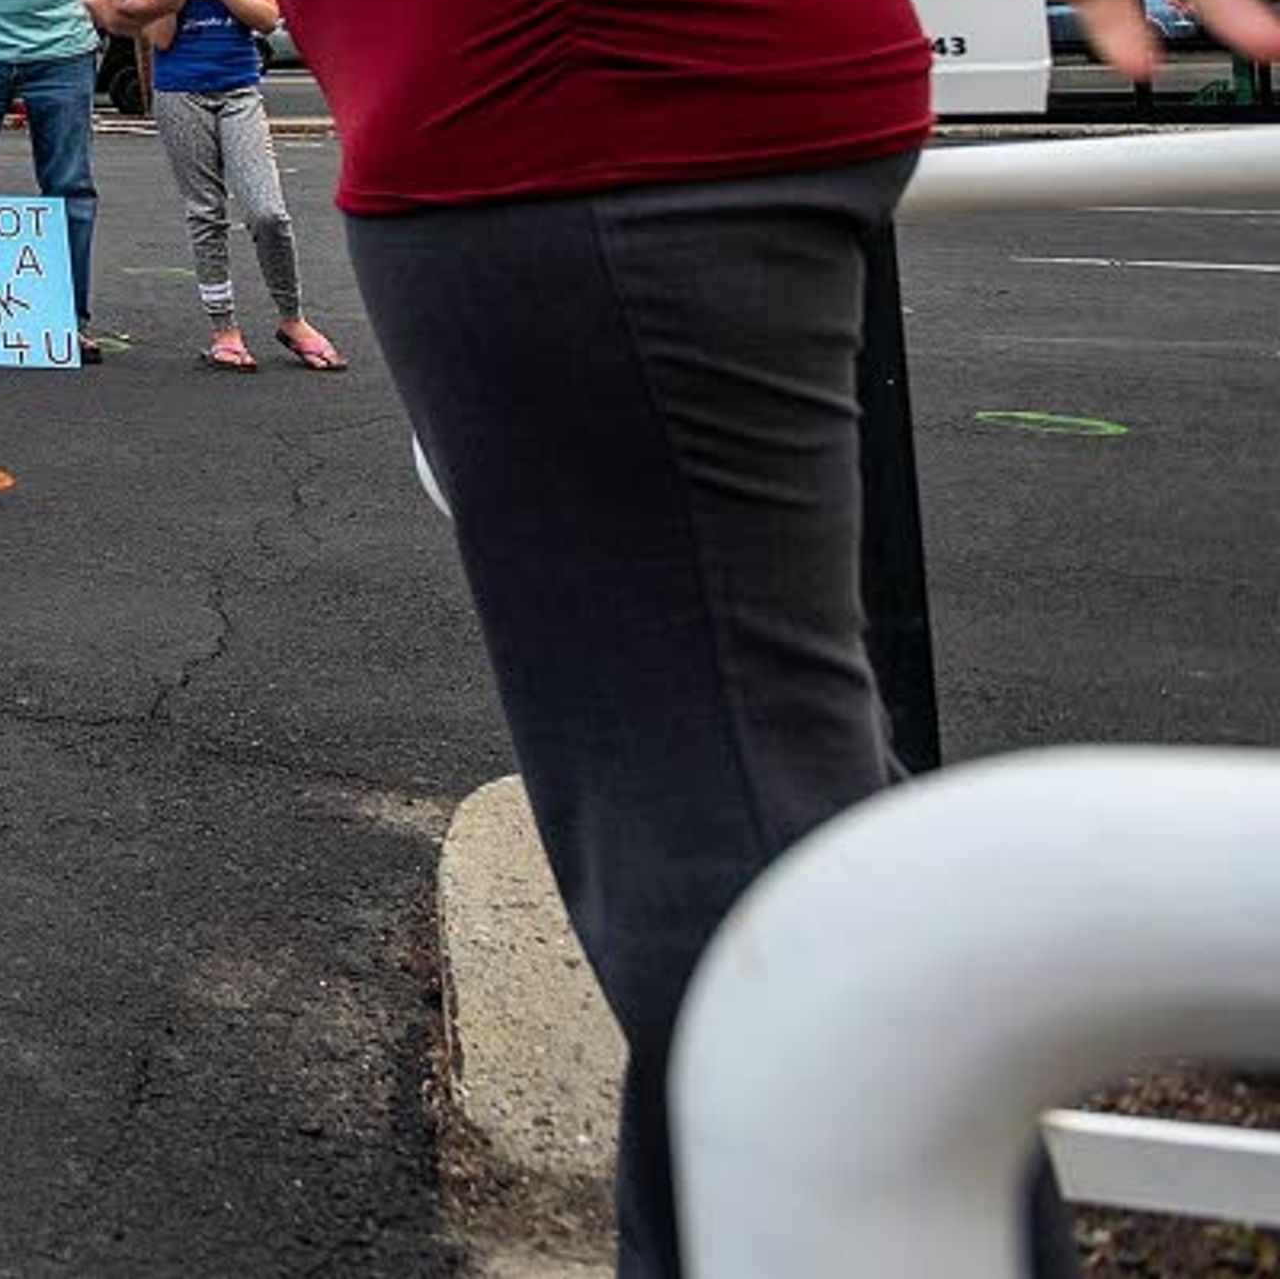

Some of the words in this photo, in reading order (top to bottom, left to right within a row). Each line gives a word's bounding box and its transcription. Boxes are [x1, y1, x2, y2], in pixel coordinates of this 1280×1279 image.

[15, 244, 43, 276] A
[2, 331, 30, 365] 4
[44, 331, 73, 365] U
